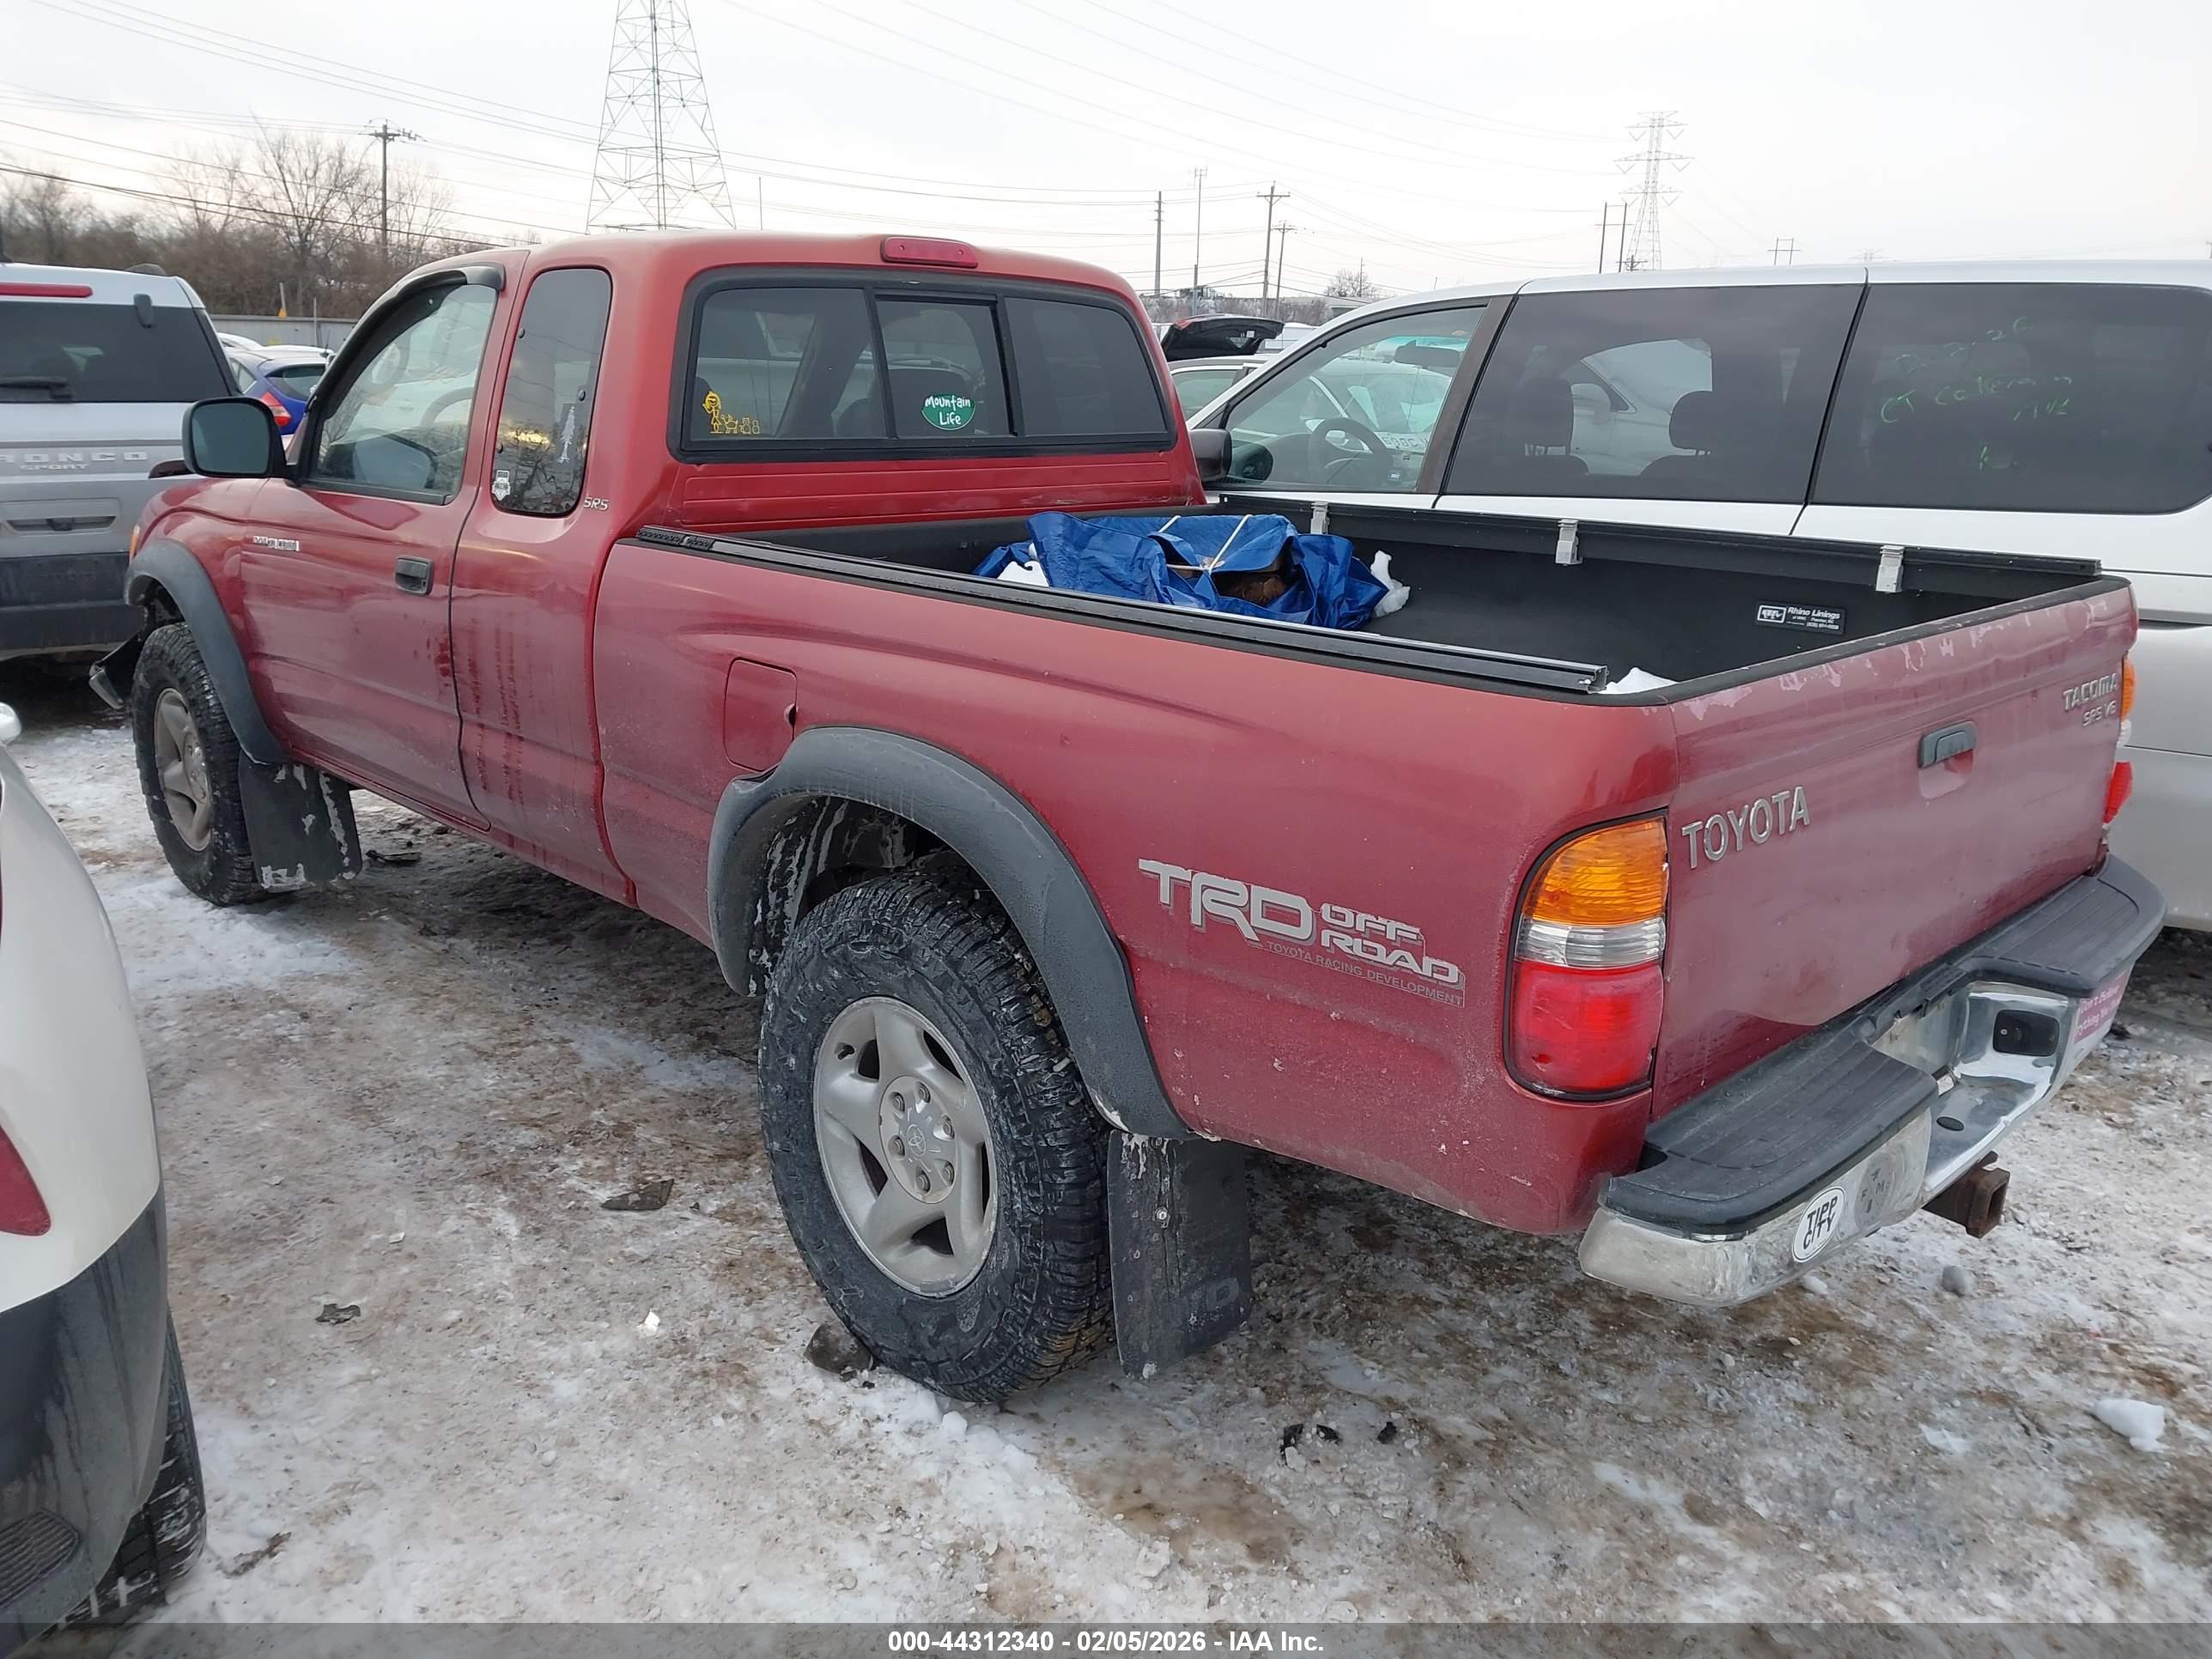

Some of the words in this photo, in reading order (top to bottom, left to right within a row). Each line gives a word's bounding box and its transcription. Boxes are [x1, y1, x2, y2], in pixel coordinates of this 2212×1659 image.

[925, 395, 971, 411] Mountain
[939, 412, 961, 425] Life
[1788, 606, 1811, 617] Rhino
[1811, 609, 1840, 621] Linings
[2063, 672, 2117, 711] TACOMA
[1681, 786, 1810, 869] TOYOTA
[1139, 859, 1314, 945] TRD
[1321, 902, 1424, 943] OFF
[1267, 941, 1313, 962] TOYOTA
[1316, 954, 1364, 975] RACING
[1366, 969, 1464, 1006] DEVELOPMENT
[1321, 929, 1464, 988] ROAD
[1803, 1212, 1836, 1250] CITY
[1807, 1195, 1838, 1231] TIPP
